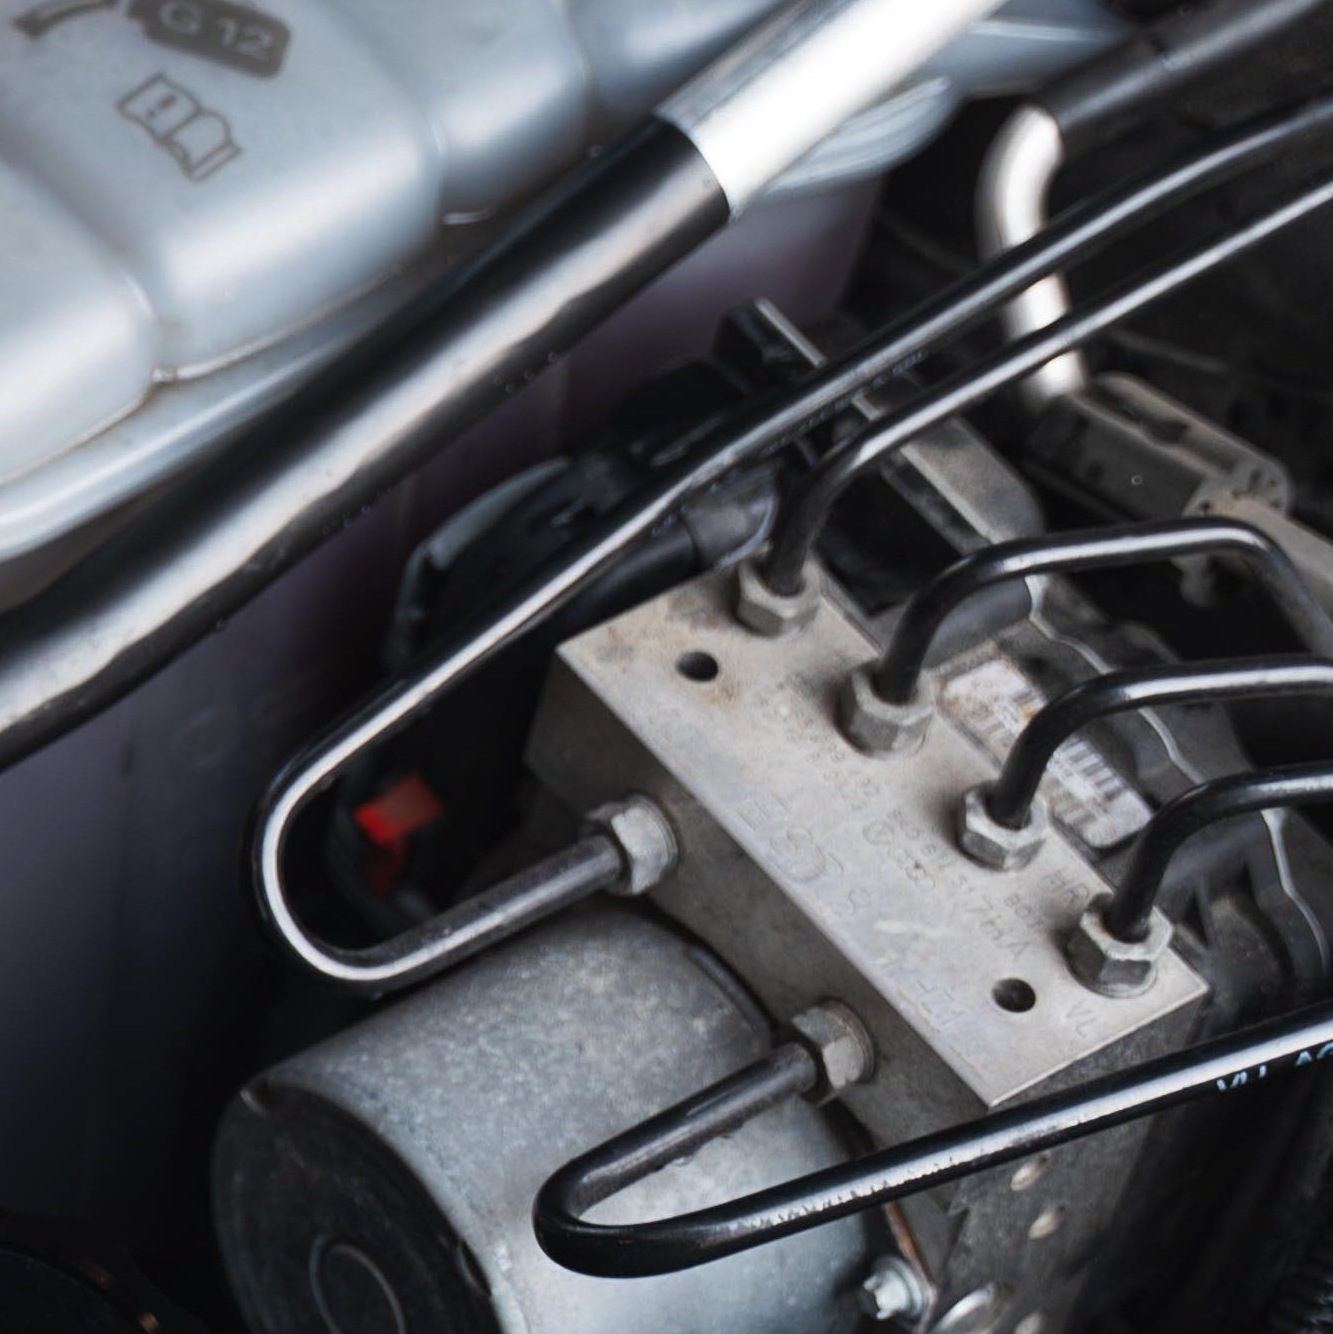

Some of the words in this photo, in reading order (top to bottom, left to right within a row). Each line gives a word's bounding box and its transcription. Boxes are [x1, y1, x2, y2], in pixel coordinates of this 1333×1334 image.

[159, 0, 201, 34] G
[217, 17, 271, 59] 12
[1039, 869, 1091, 908] HR
